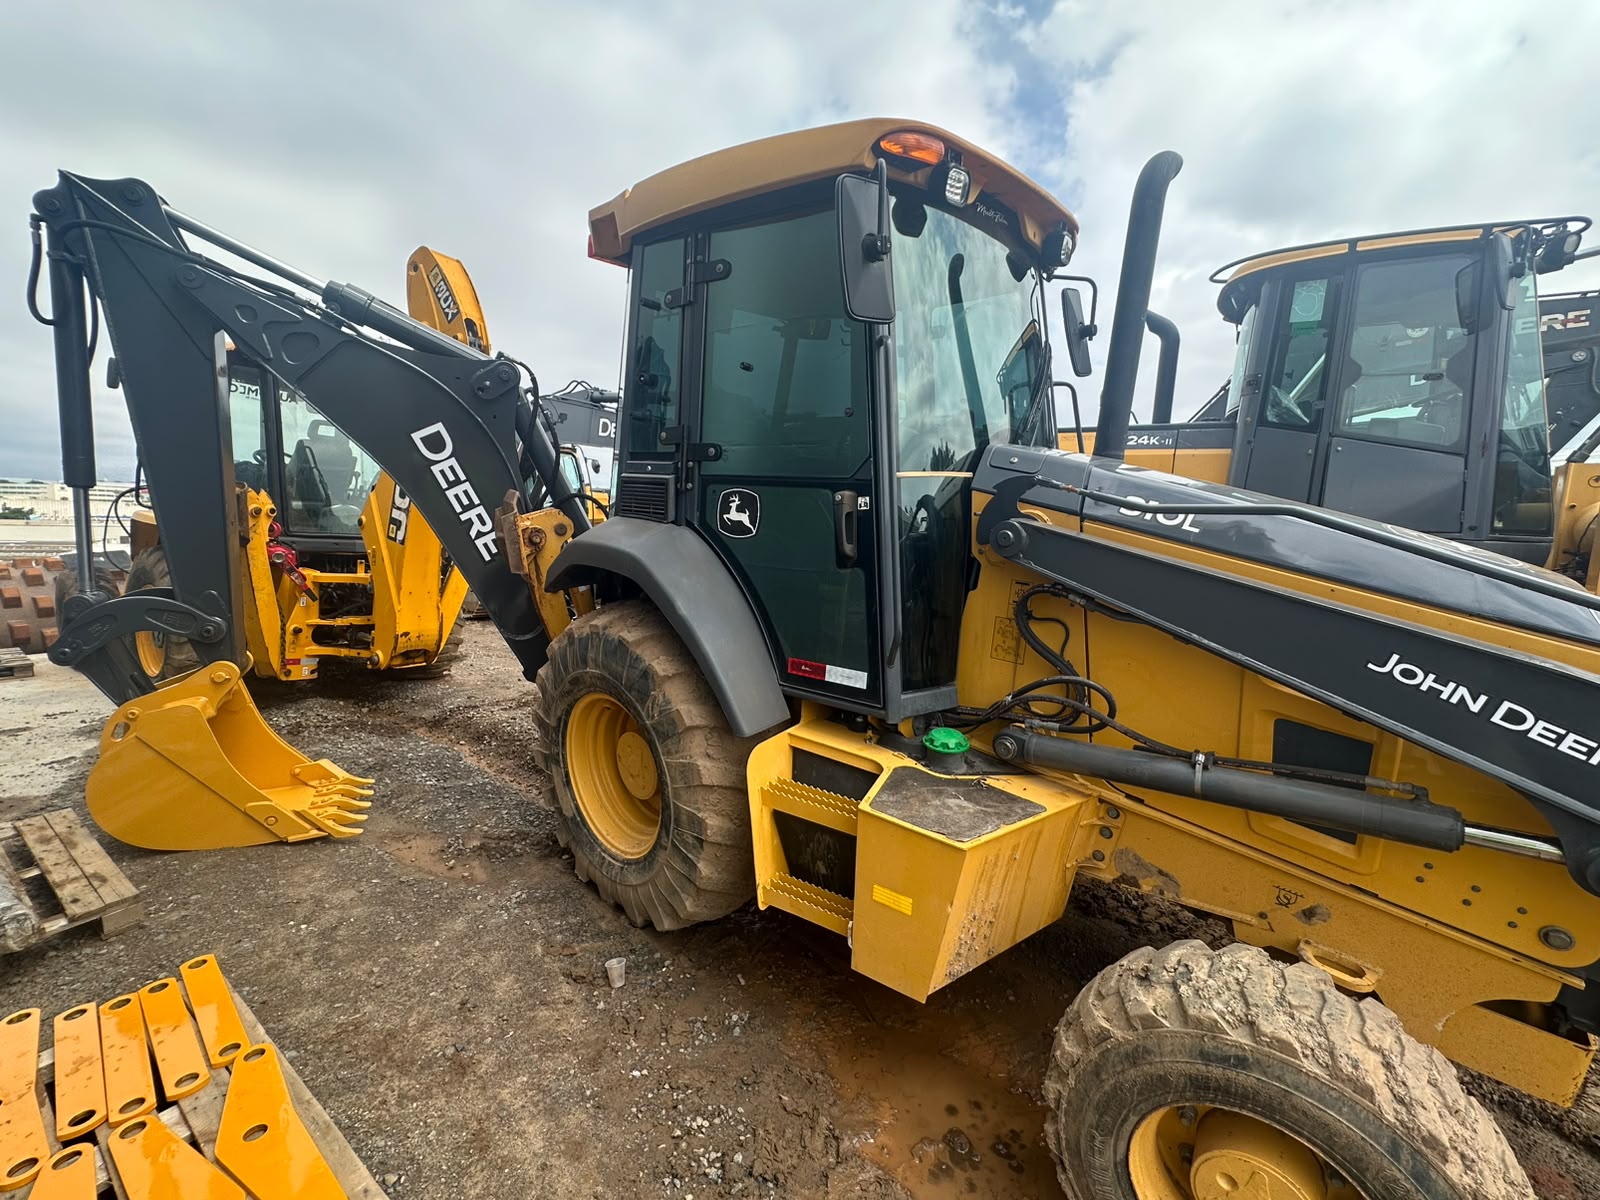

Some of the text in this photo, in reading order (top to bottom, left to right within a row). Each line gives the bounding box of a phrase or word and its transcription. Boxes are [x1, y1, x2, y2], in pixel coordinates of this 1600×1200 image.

[1126, 435, 1173, 446] 24K-II
[391, 484, 411, 543] JC
[410, 421, 499, 562] DEERE
[1367, 653, 1488, 713] JOHN
